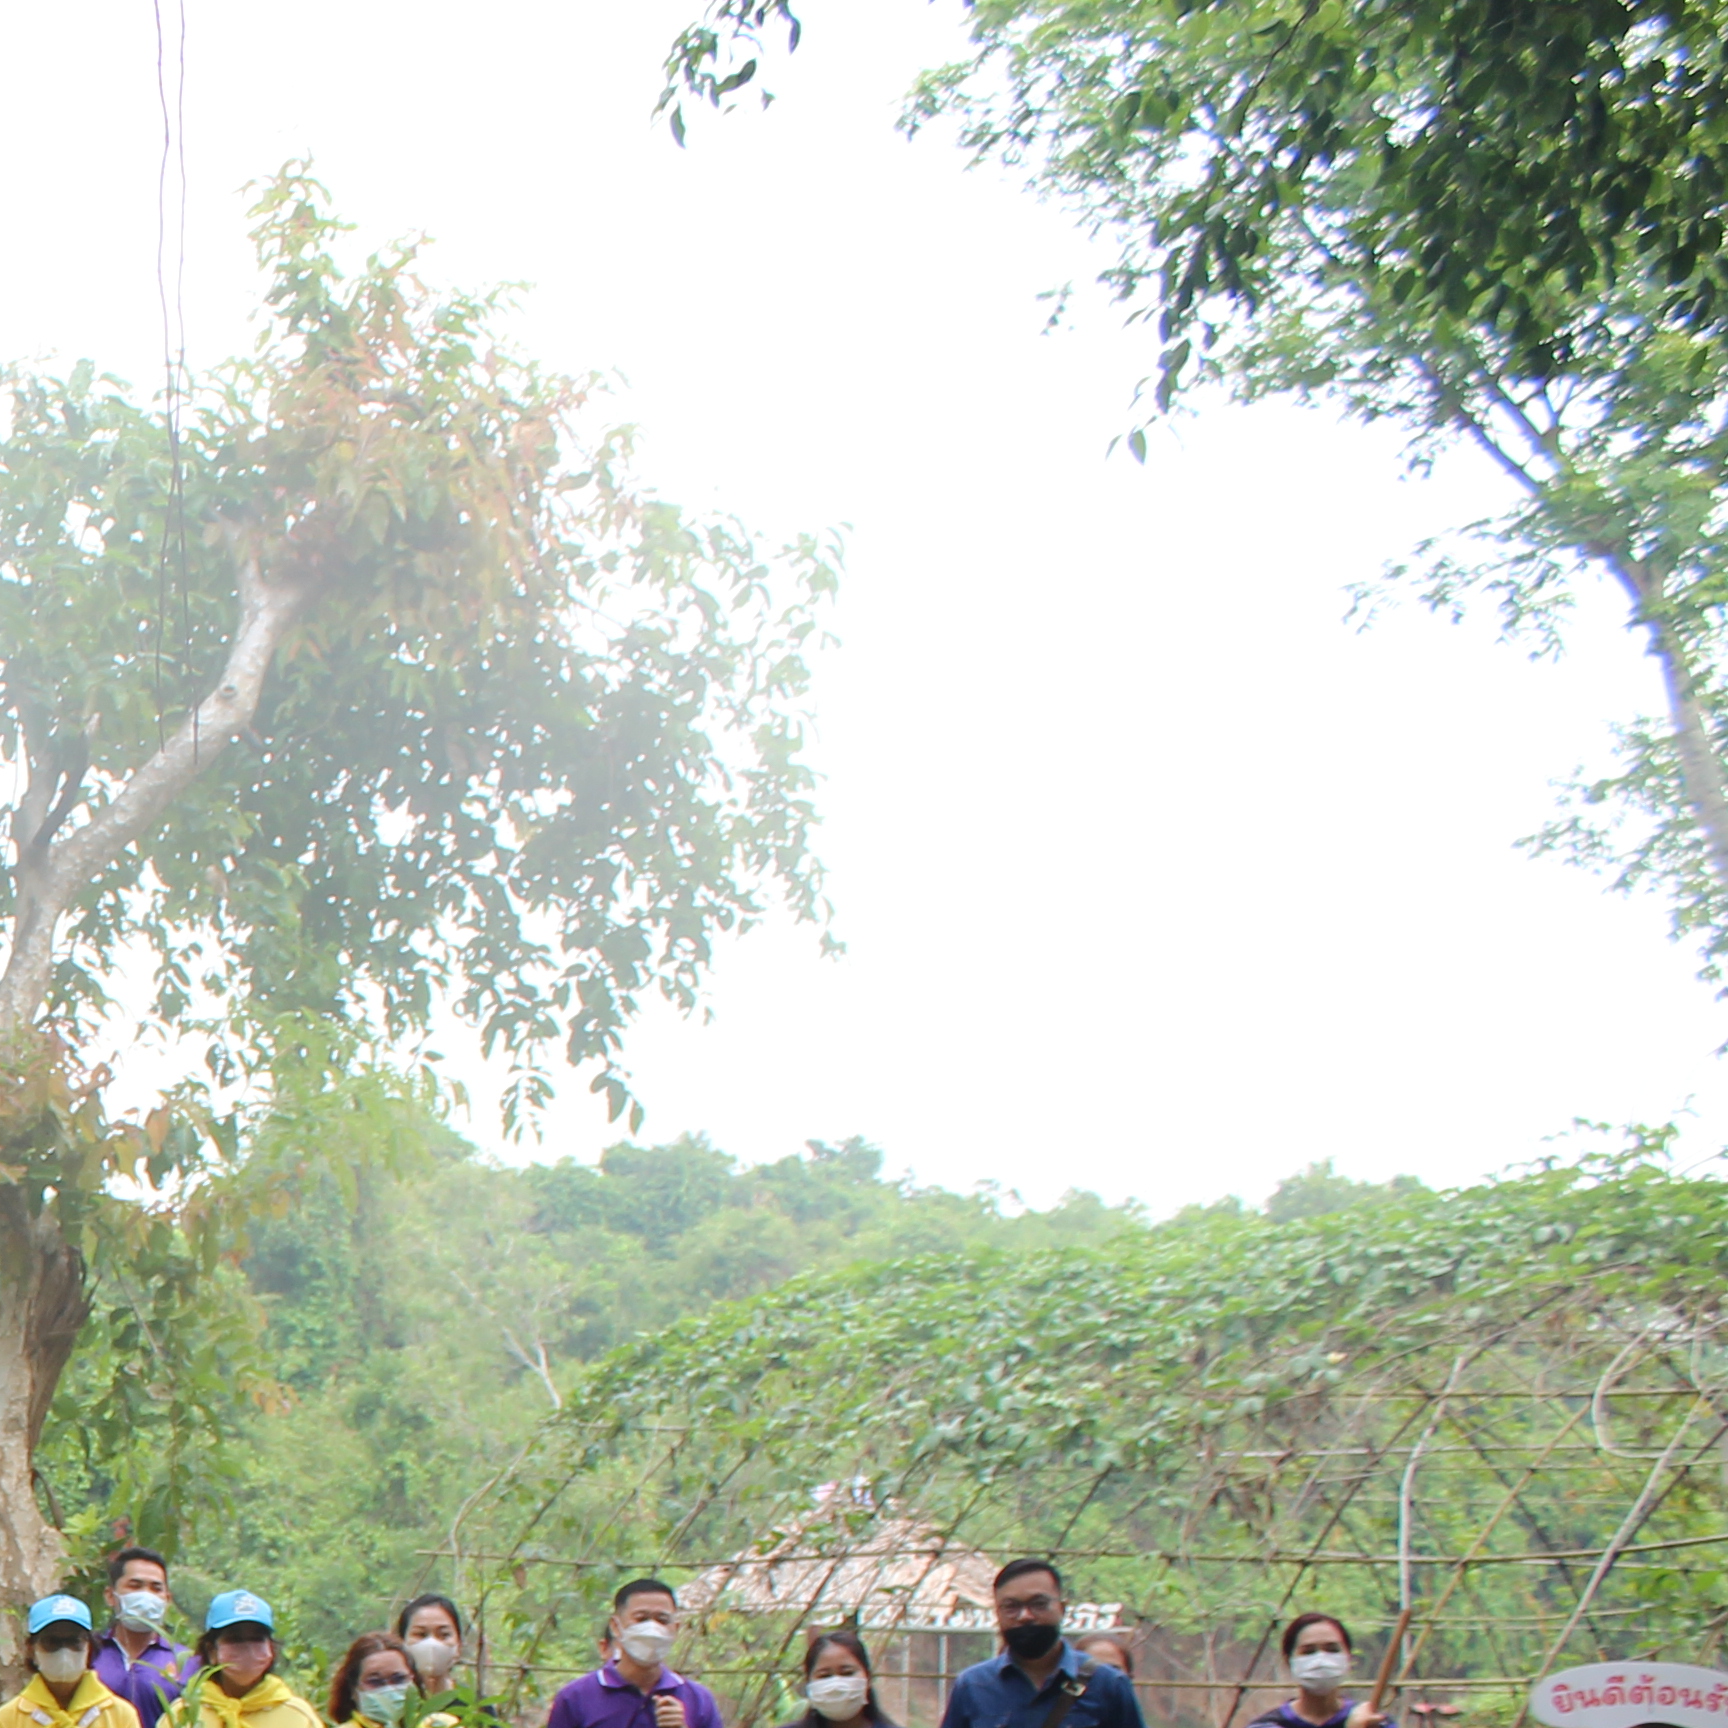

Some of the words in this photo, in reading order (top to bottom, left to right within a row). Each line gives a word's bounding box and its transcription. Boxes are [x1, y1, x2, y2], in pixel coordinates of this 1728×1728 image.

[1552, 1674, 1728, 1717] ยินดีต้อนรั
